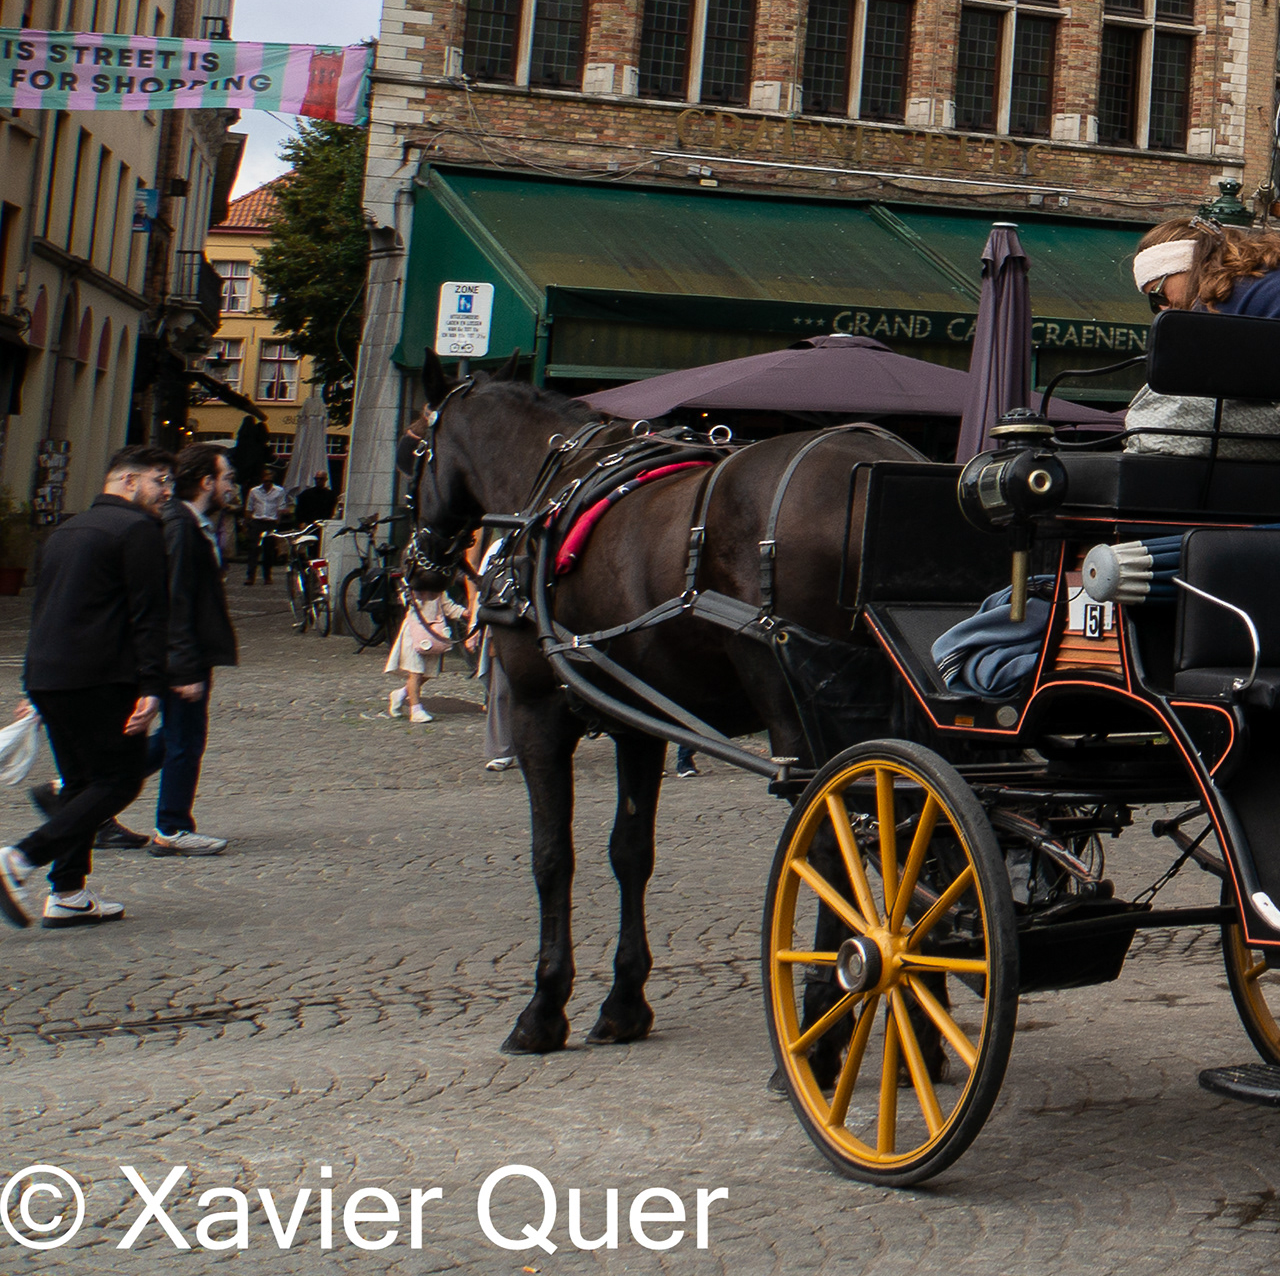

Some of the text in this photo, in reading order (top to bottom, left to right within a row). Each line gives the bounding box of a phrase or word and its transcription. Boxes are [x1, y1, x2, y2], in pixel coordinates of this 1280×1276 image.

[49, 44, 177, 70] STREET
[188, 52, 221, 73] IS
[9, 69, 272, 94] FOR SHOPPING
[455, 285, 480, 294] ZONE
[832, 311, 932, 338] GRAND
[1031, 322, 1148, 350] CRAENEN
[1089, 606, 1099, 635] 5
